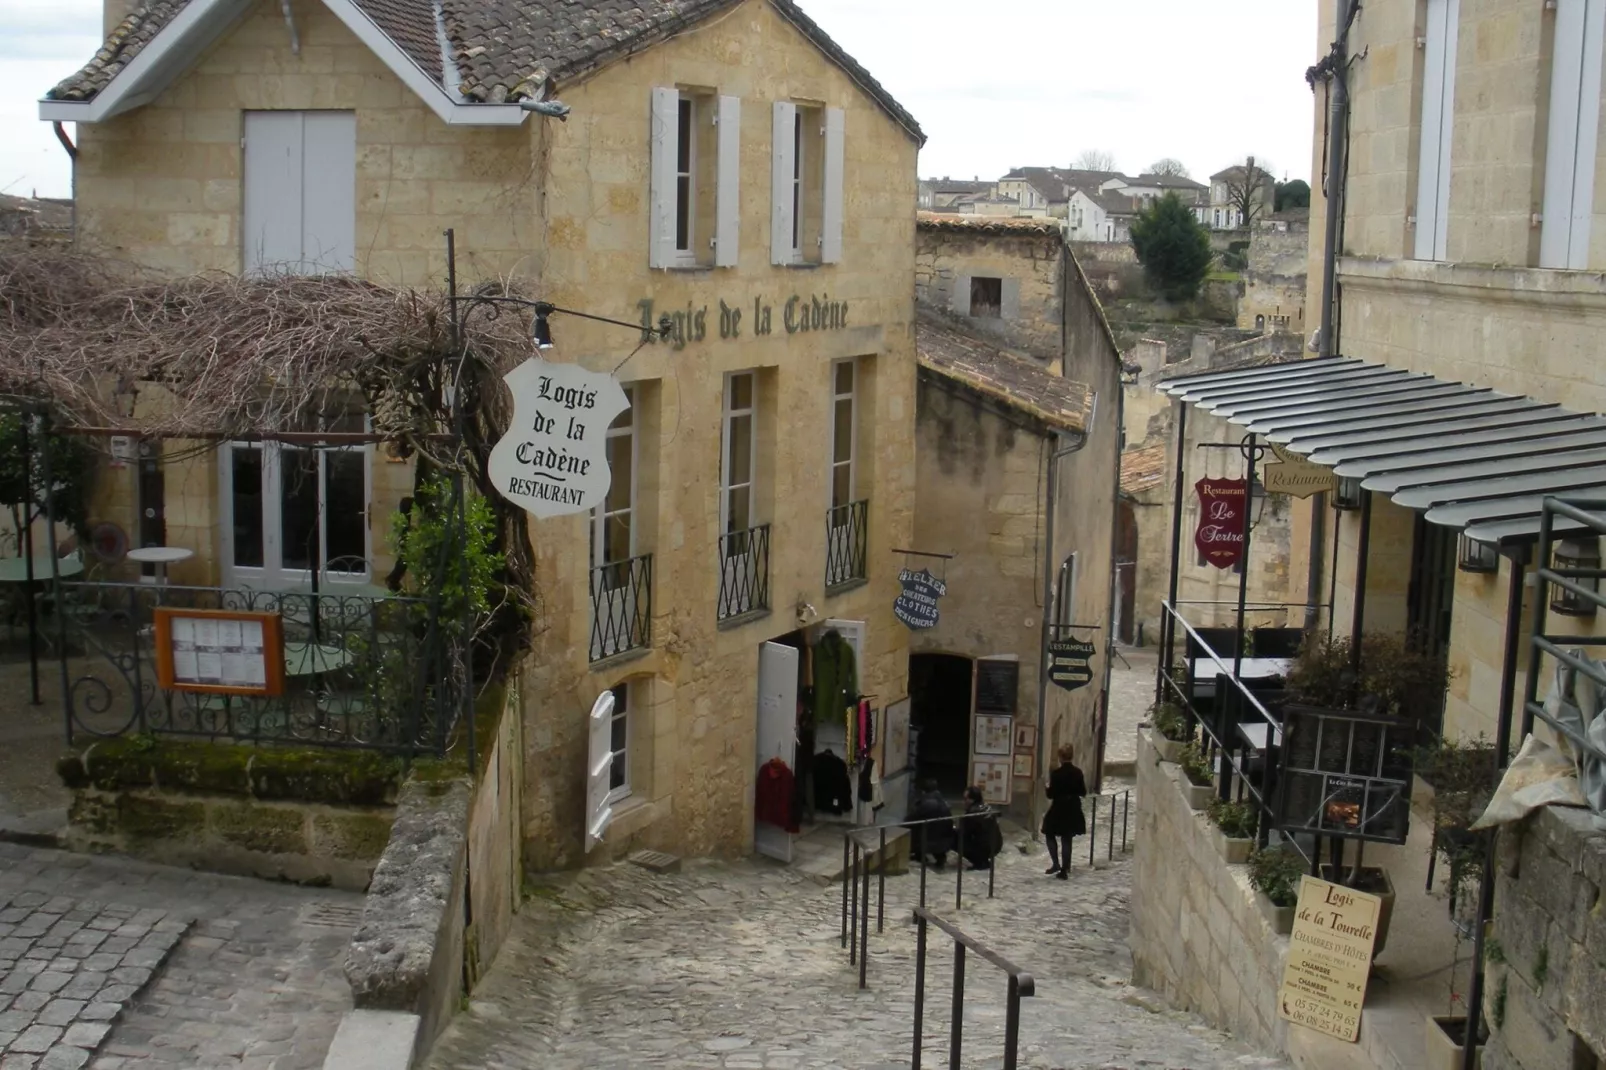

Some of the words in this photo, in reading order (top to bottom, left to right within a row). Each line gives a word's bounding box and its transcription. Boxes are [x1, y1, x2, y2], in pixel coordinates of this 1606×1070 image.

[719, 298, 742, 339] de
[754, 294, 772, 336] la
[537, 376, 598, 410] Logis
[533, 409, 556, 435] de
[566, 416, 585, 440] la
[516, 441, 590, 476] Cadène
[508, 477, 585, 506] RESTAURANT
[1203, 484, 1245, 498] Restaurant
[1209, 500, 1235, 519] Le
[1200, 524, 1243, 543] Tertre
[895, 606, 934, 627] DESIGNERS
[897, 596, 938, 618] CLOTHES
[1324, 885, 1355, 907] Logis
[1298, 907, 1311, 921] de
[1313, 911, 1324, 926] la
[1330, 911, 1372, 940] Tourelle
[1294, 929, 1333, 951] CHAMBRES
[1302, 960, 1331, 975] CHAMBRE
[1298, 977, 1327, 992] CHAMBRE
[1295, 999, 1306, 1009] 05
[1308, 1002, 1319, 1012] 57
[1319, 1006, 1330, 1017] 24
[1332, 1011, 1343, 1020] 79
[1344, 1015, 1356, 1026] 65
[1293, 1011, 1304, 1021] 06
[1306, 1015, 1318, 1025] 08
[1319, 1019, 1331, 1029] 25
[1332, 1023, 1341, 1034] 14
[1343, 1028, 1353, 1038] 51
